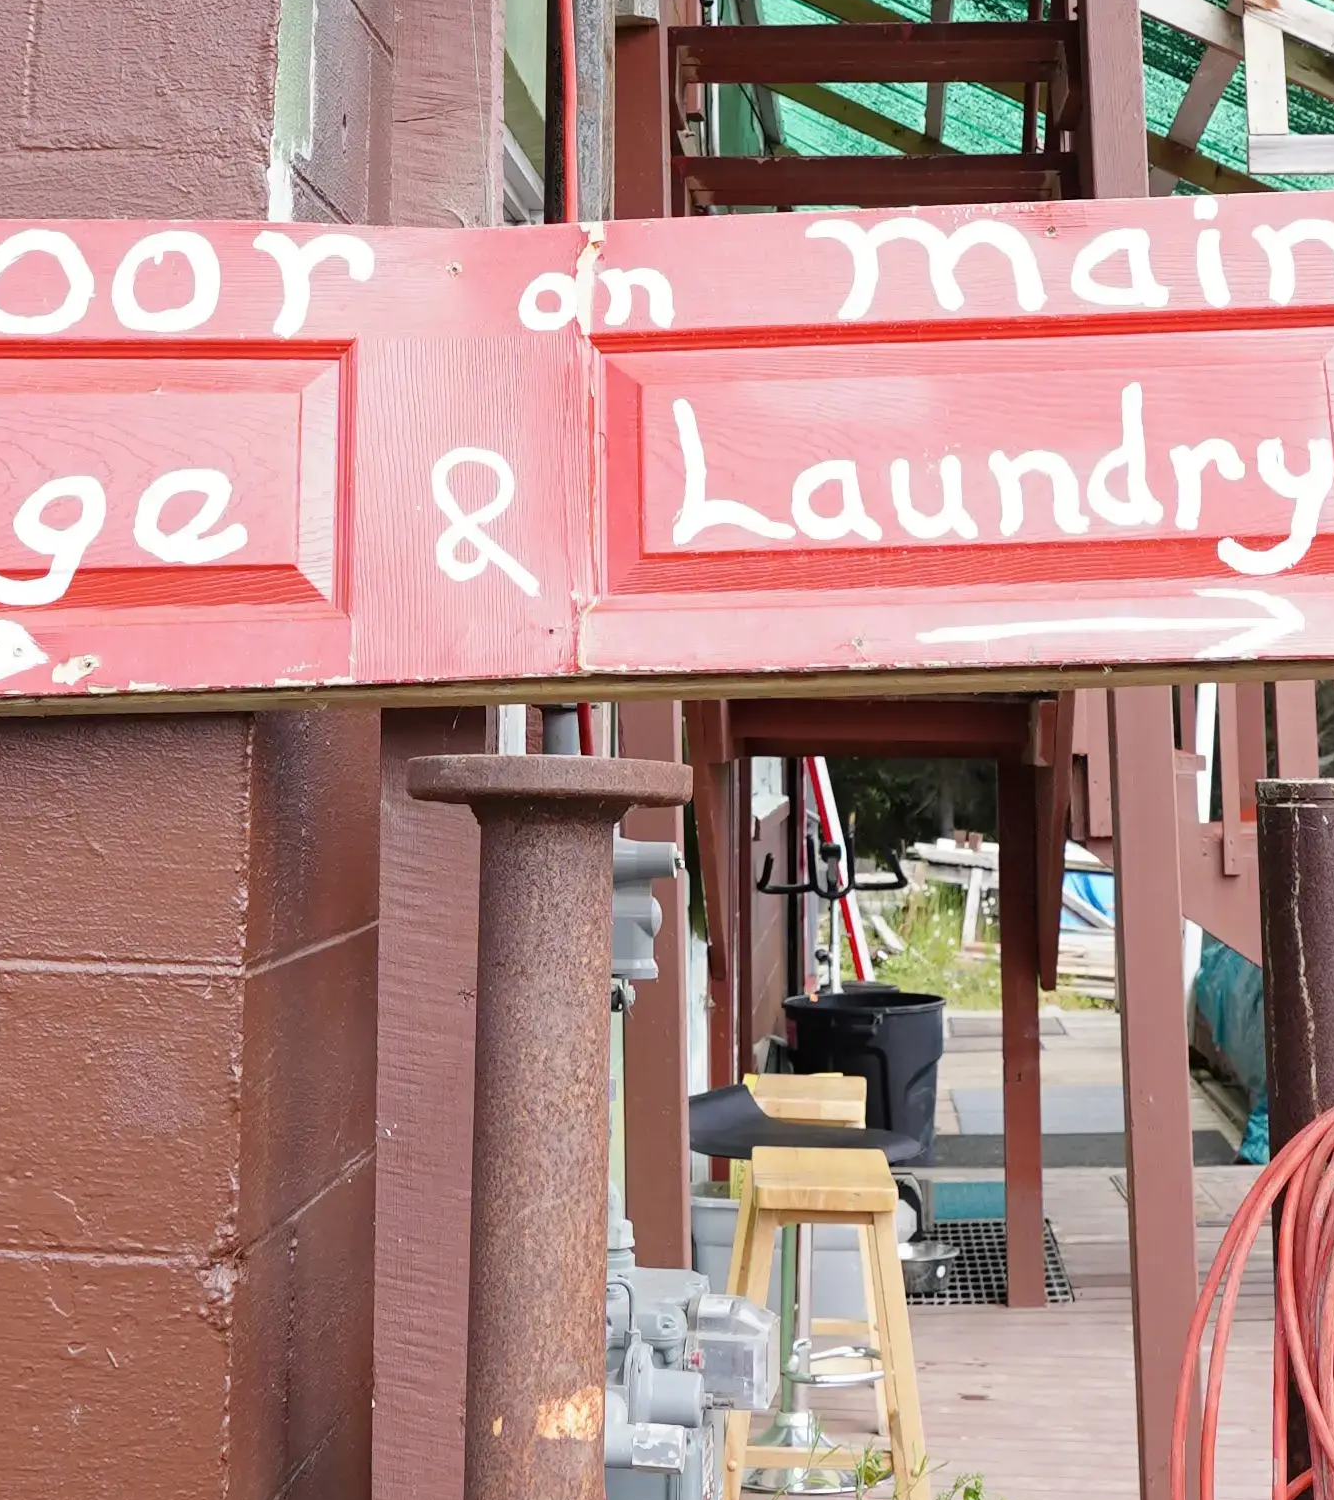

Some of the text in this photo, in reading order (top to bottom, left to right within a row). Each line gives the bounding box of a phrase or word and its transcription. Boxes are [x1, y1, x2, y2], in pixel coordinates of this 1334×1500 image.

[517, 256, 676, 332] on
[430, 445, 542, 597] &
[671, 380, 1334, 576] Laundry
